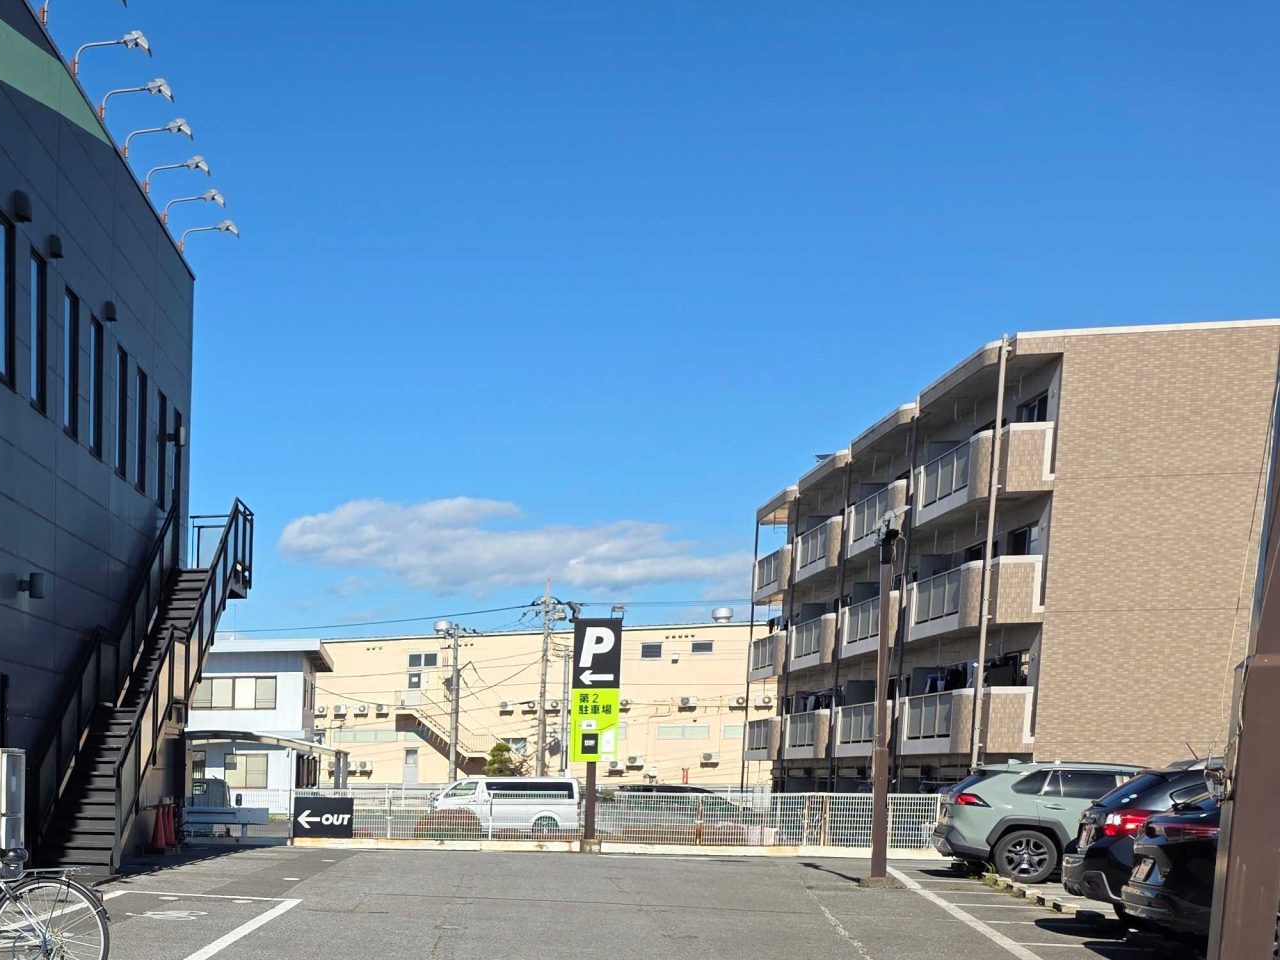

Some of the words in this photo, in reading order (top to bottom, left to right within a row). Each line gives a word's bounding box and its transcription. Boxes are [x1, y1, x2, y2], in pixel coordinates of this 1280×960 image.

[578, 626, 615, 667] P
[578, 704, 612, 715] 駐車場
[321, 813, 351, 826] OUT
